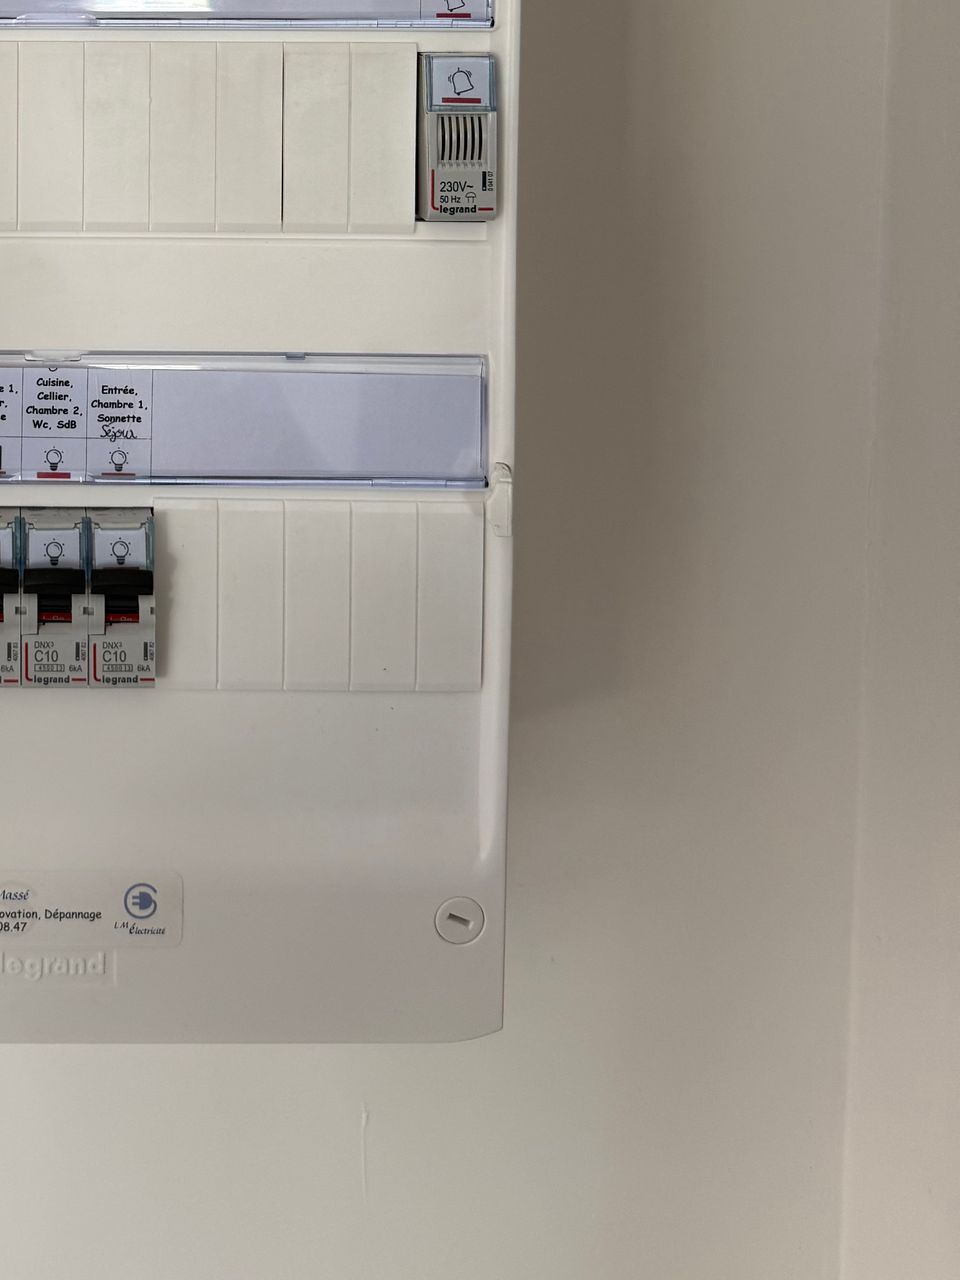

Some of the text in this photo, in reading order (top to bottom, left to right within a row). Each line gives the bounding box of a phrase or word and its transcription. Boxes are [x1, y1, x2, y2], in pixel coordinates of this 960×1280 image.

[440, 195, 461, 204] 50 Hz
[440, 205, 477, 214] legrand
[36, 377, 73, 389] Cuisine,
[8, 384, 18, 394] 1,
[101, 385, 138, 396] Entrée,
[37, 391, 72, 402] Cellier,
[25, 405, 83, 417] Chambre 2,
[90, 400, 148, 411] Chambre 1,
[97, 413, 142, 424] Sonnette
[32, 420, 77, 431] Wc, SdB
[34, 650, 59, 662] C10
[102, 650, 127, 662] C10
[34, 675, 70, 685] legrand
[102, 675, 138, 685] legrand
[44, 909, 102, 921] Dépannage
